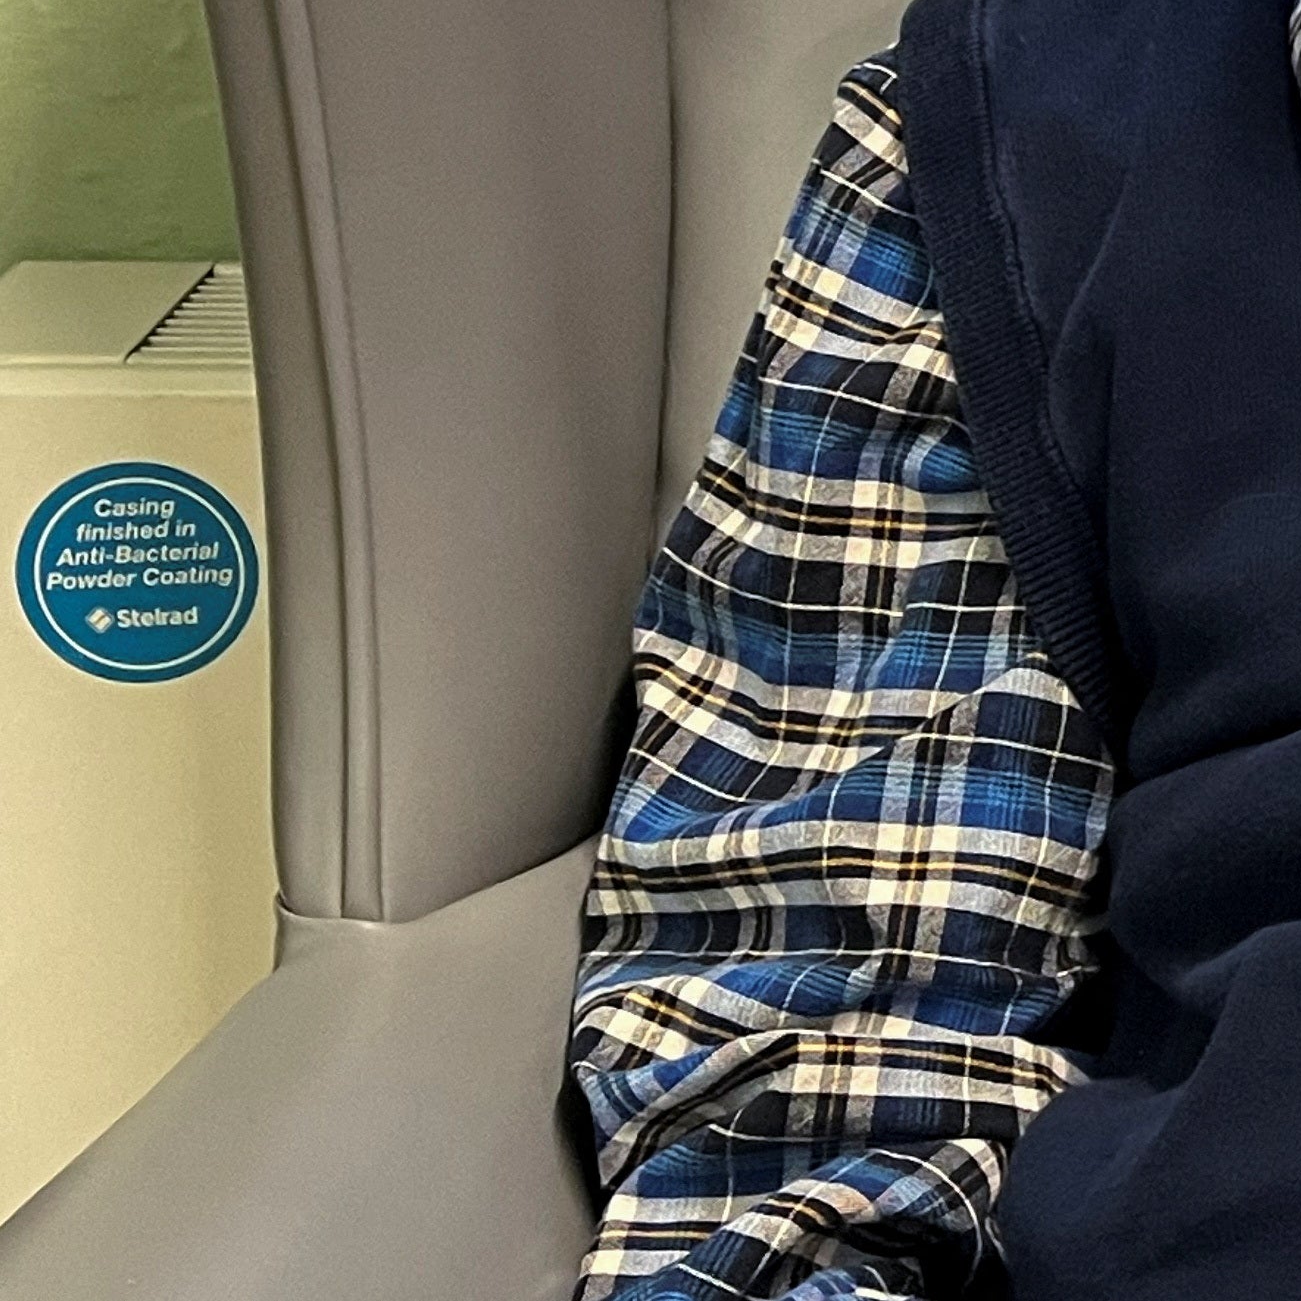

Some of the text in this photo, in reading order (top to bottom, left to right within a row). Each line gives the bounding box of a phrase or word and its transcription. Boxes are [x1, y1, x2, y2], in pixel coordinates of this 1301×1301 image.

[93, 497, 176, 519] Casing
[76, 519, 196, 543] finished in
[56, 541, 220, 567] Anti-Bacterial
[46, 566, 234, 590] Powder Coating
[116, 606, 199, 628] Stelrad
